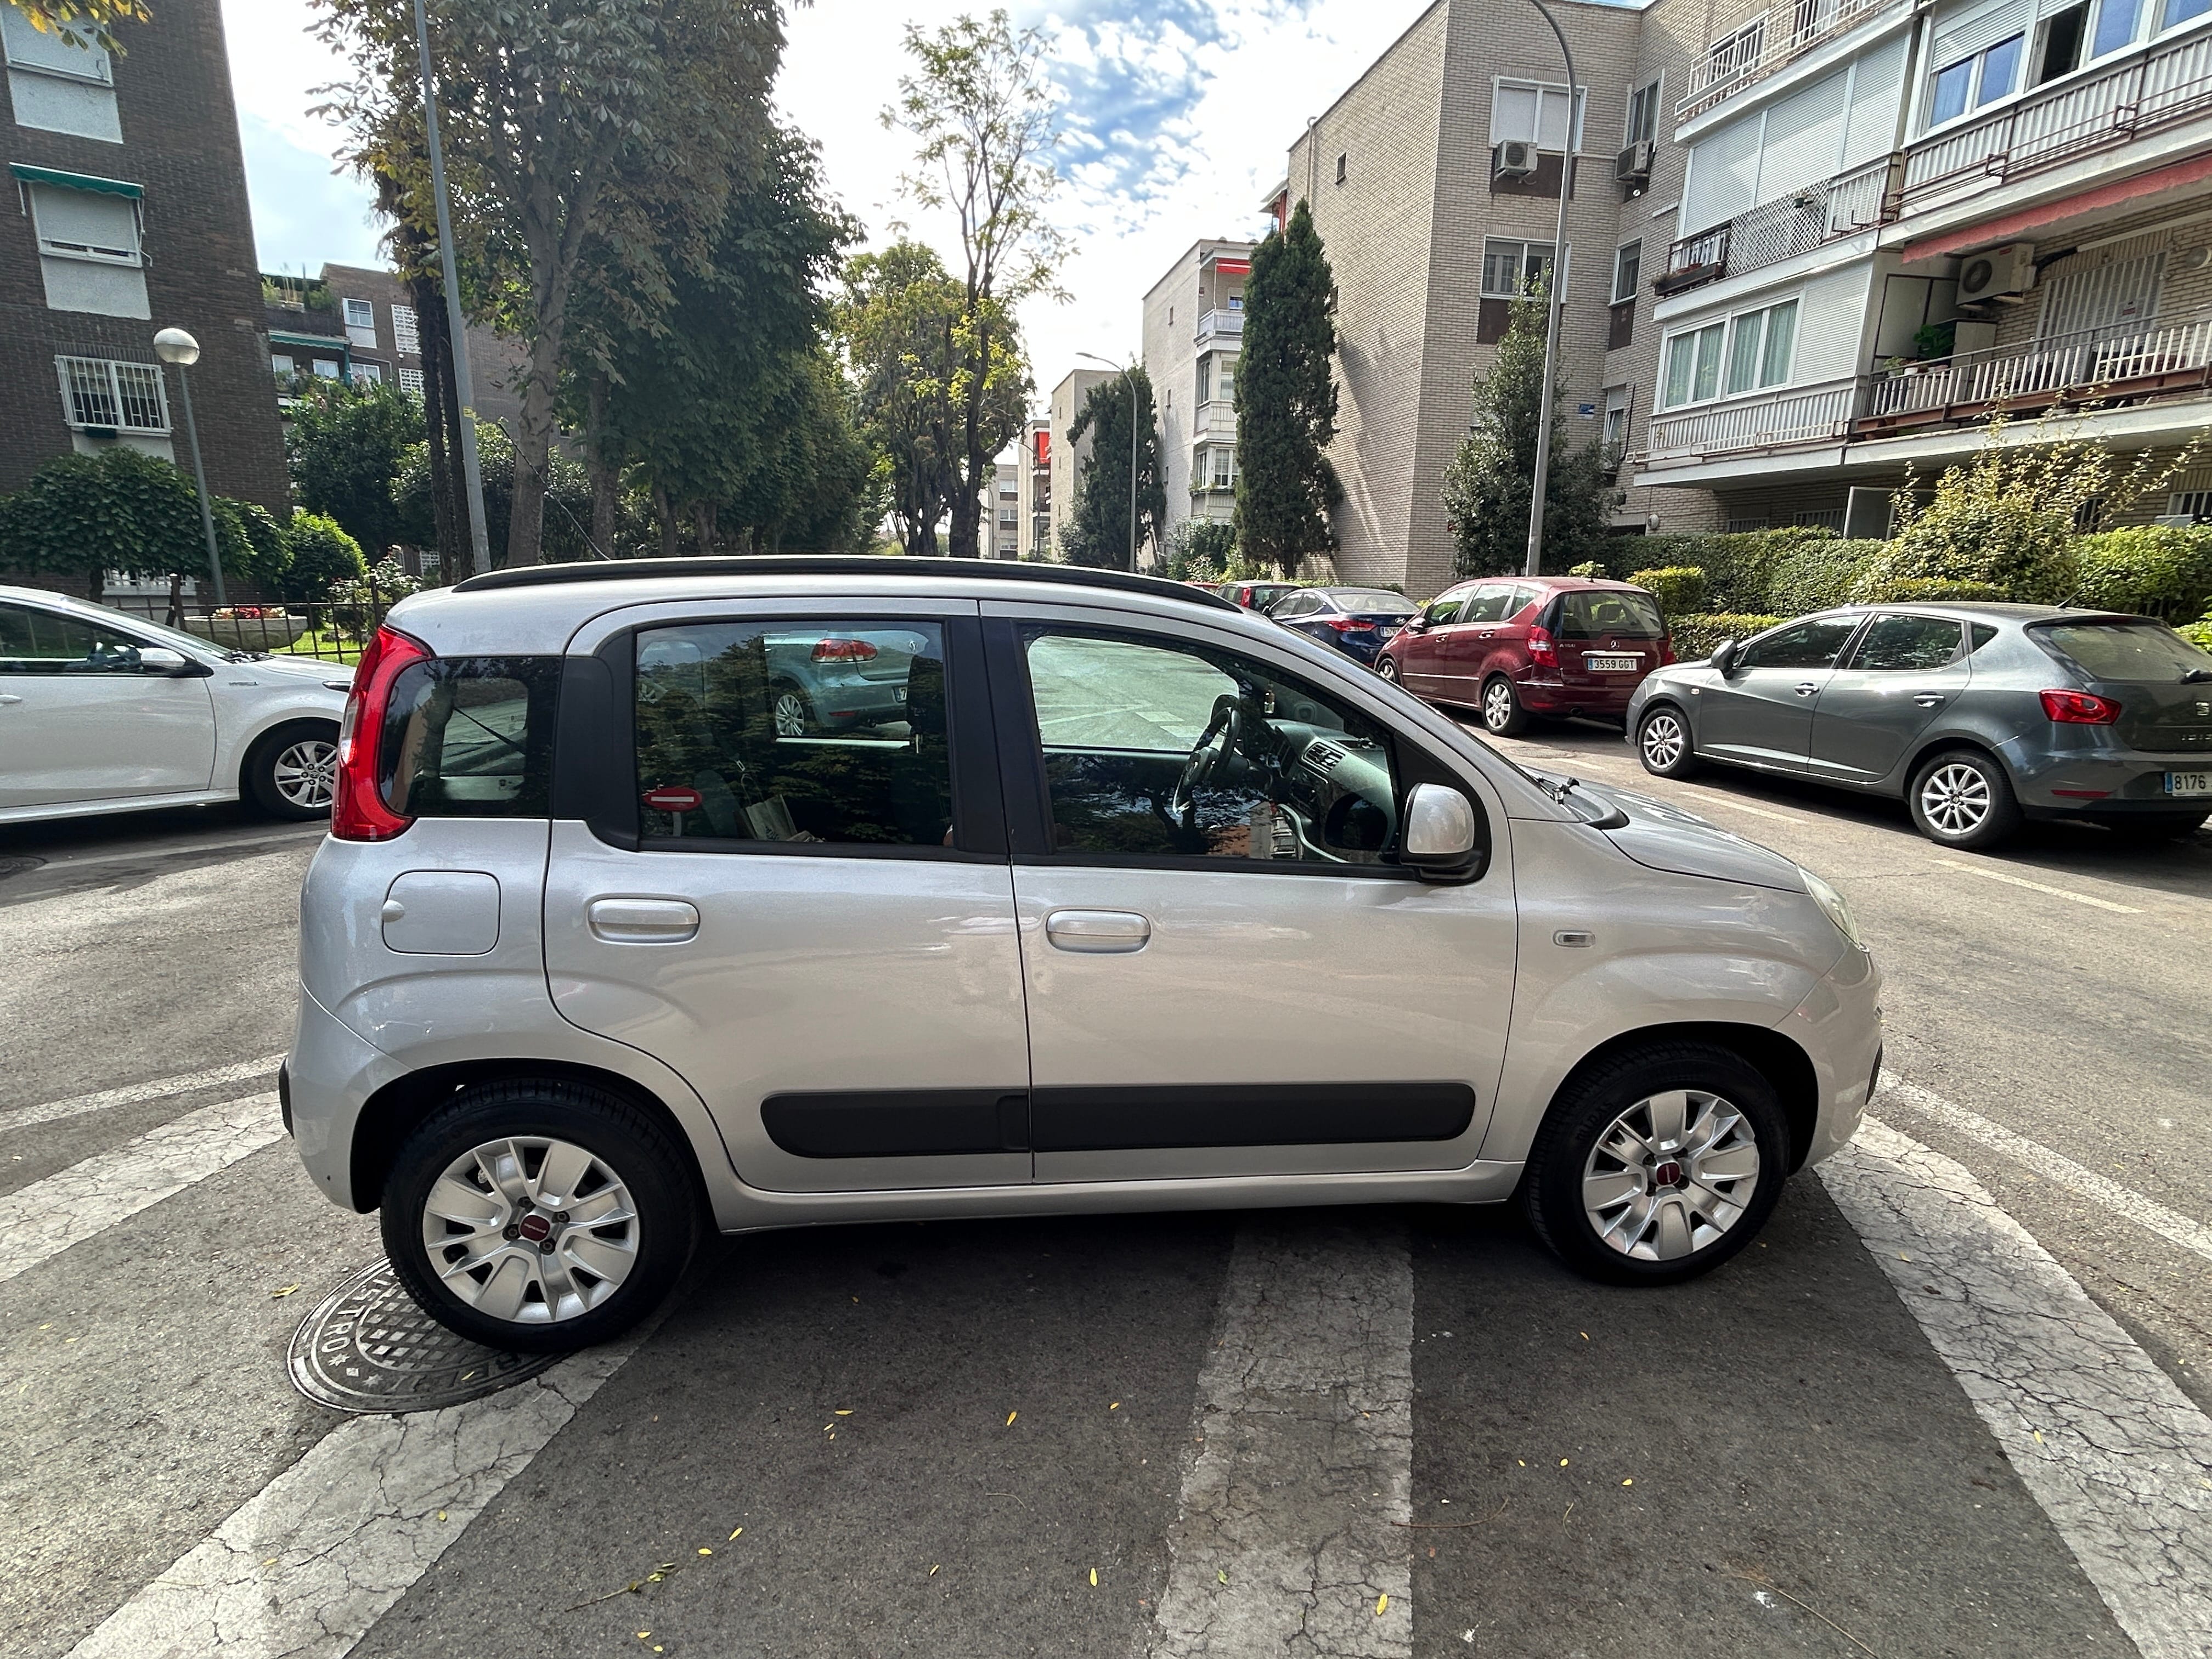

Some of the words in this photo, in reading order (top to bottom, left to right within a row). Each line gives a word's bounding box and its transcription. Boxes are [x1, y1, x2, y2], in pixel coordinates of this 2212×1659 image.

[1594, 659, 1616, 669] 3559
[1618, 659, 1634, 669] GGT
[2174, 775, 2207, 789] 8176
